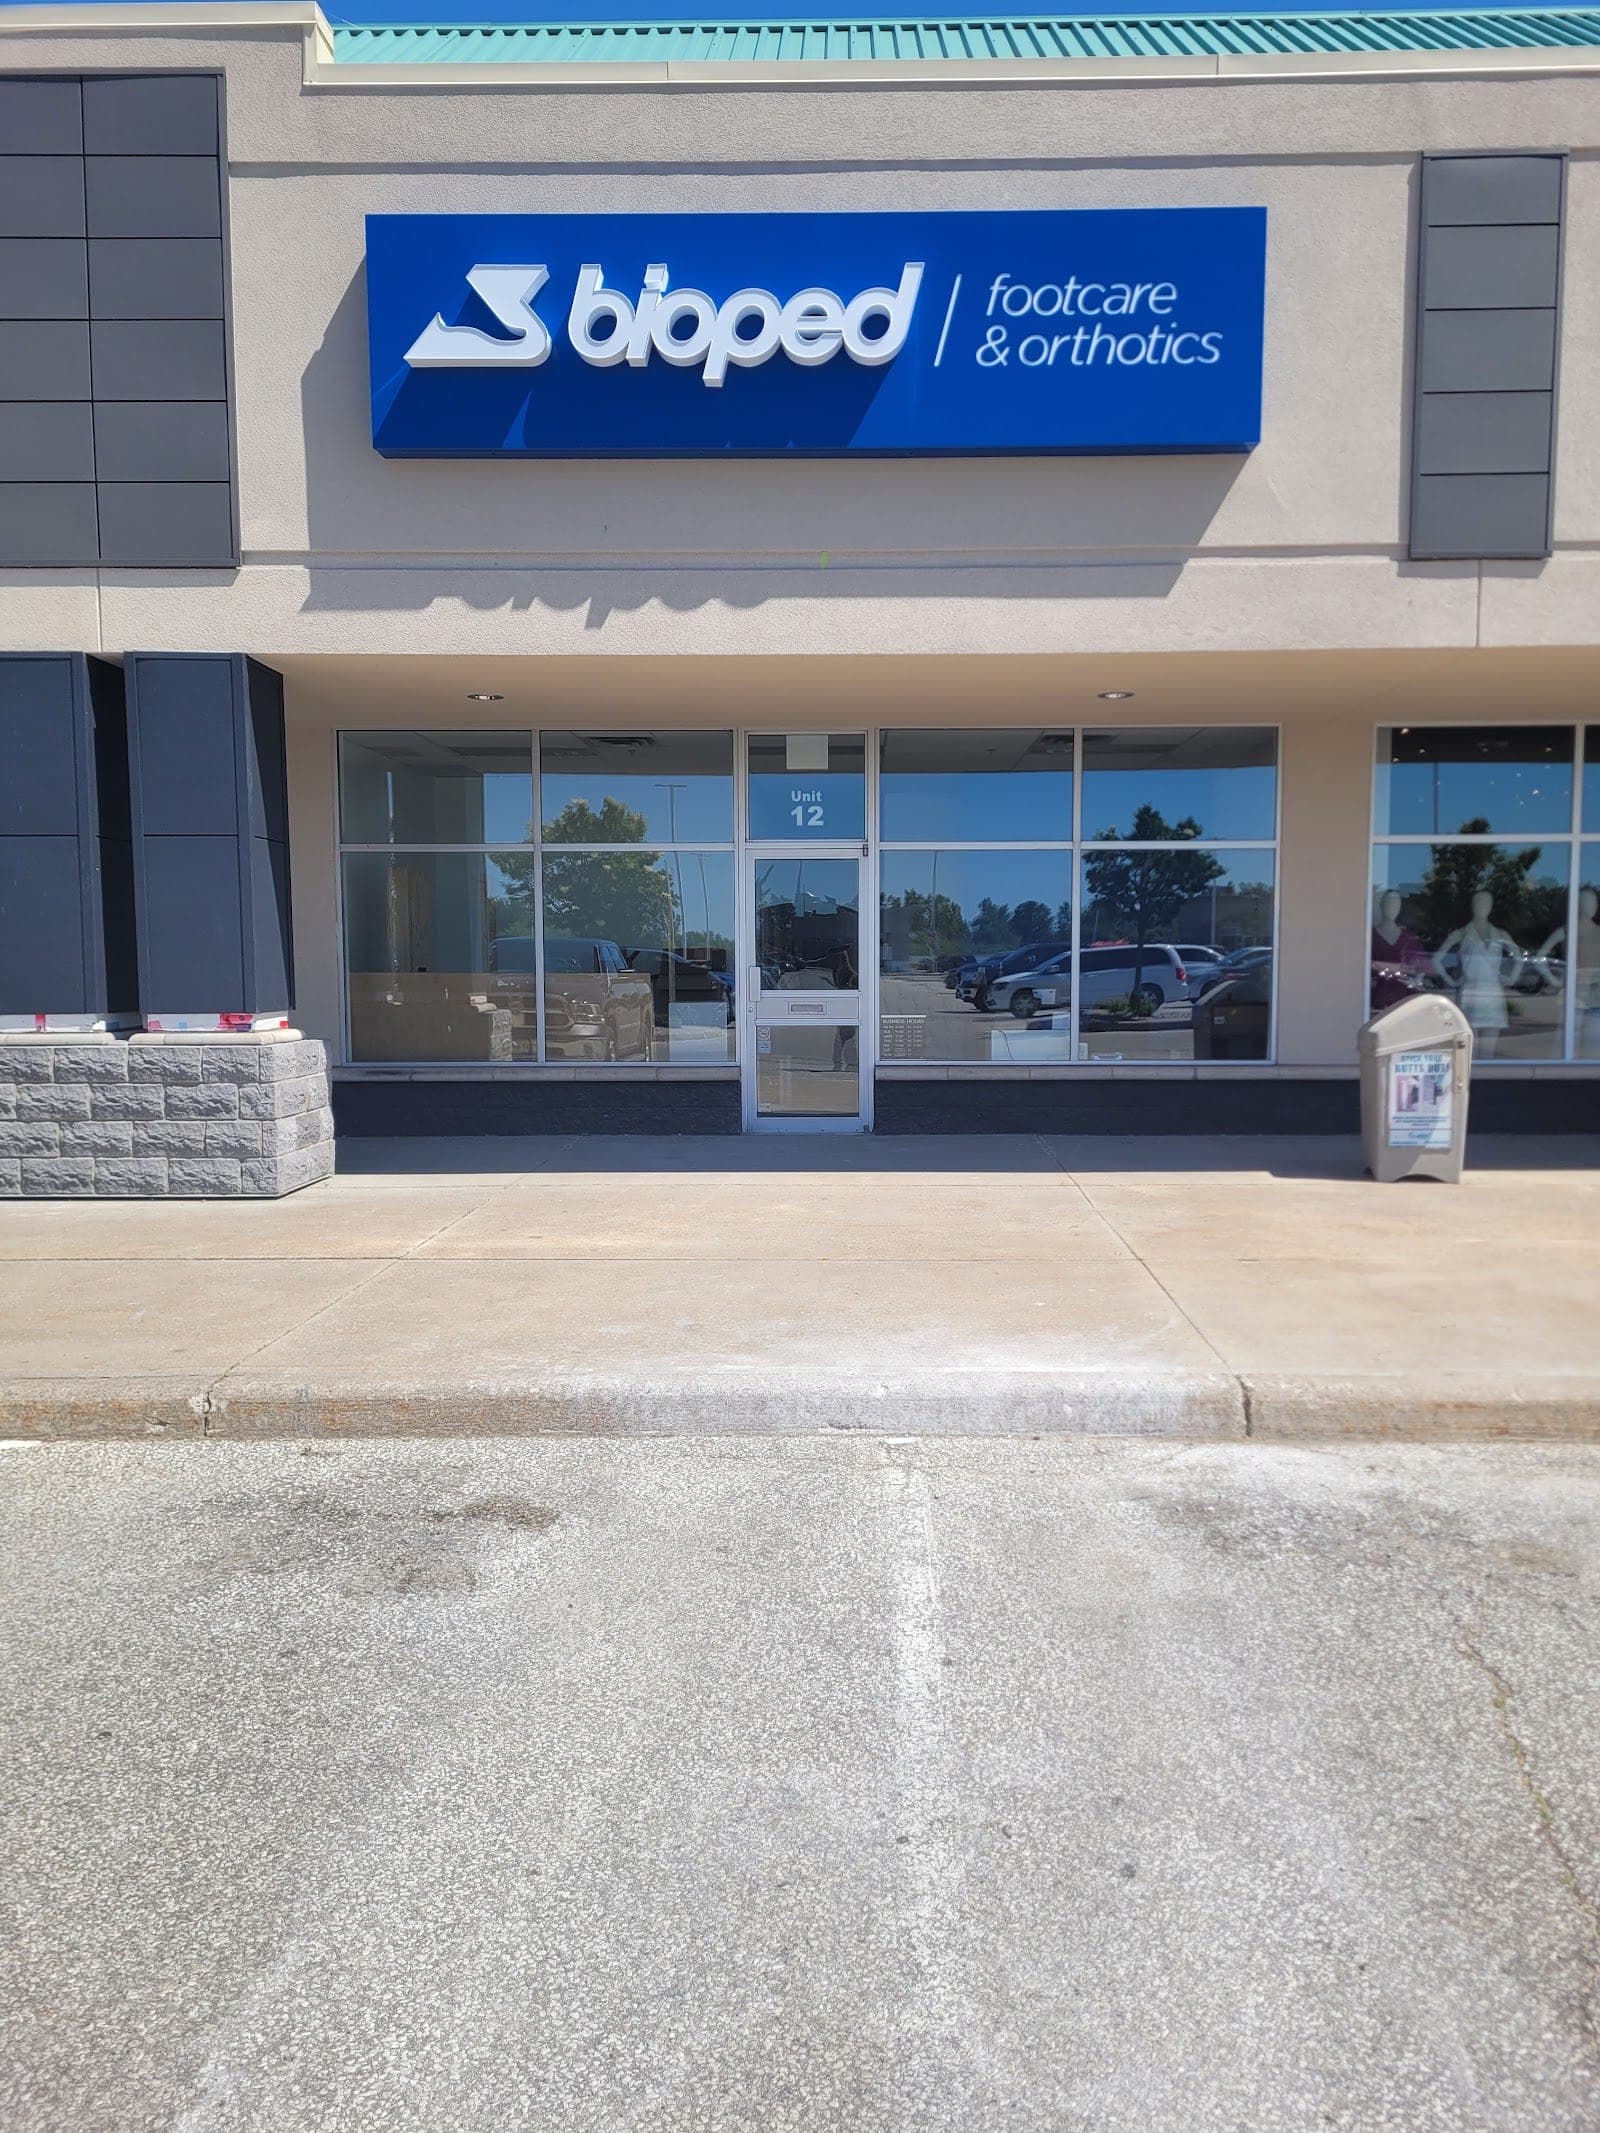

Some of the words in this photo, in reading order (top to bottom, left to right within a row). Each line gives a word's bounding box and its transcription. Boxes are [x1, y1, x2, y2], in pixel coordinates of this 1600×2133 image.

[986, 273, 1178, 316] footcare
[568, 262, 925, 387] bioped
[975, 324, 1010, 367] &
[1018, 322, 1223, 366] orthotics
[791, 790, 822, 802] Unit
[791, 805, 824, 826] 12
